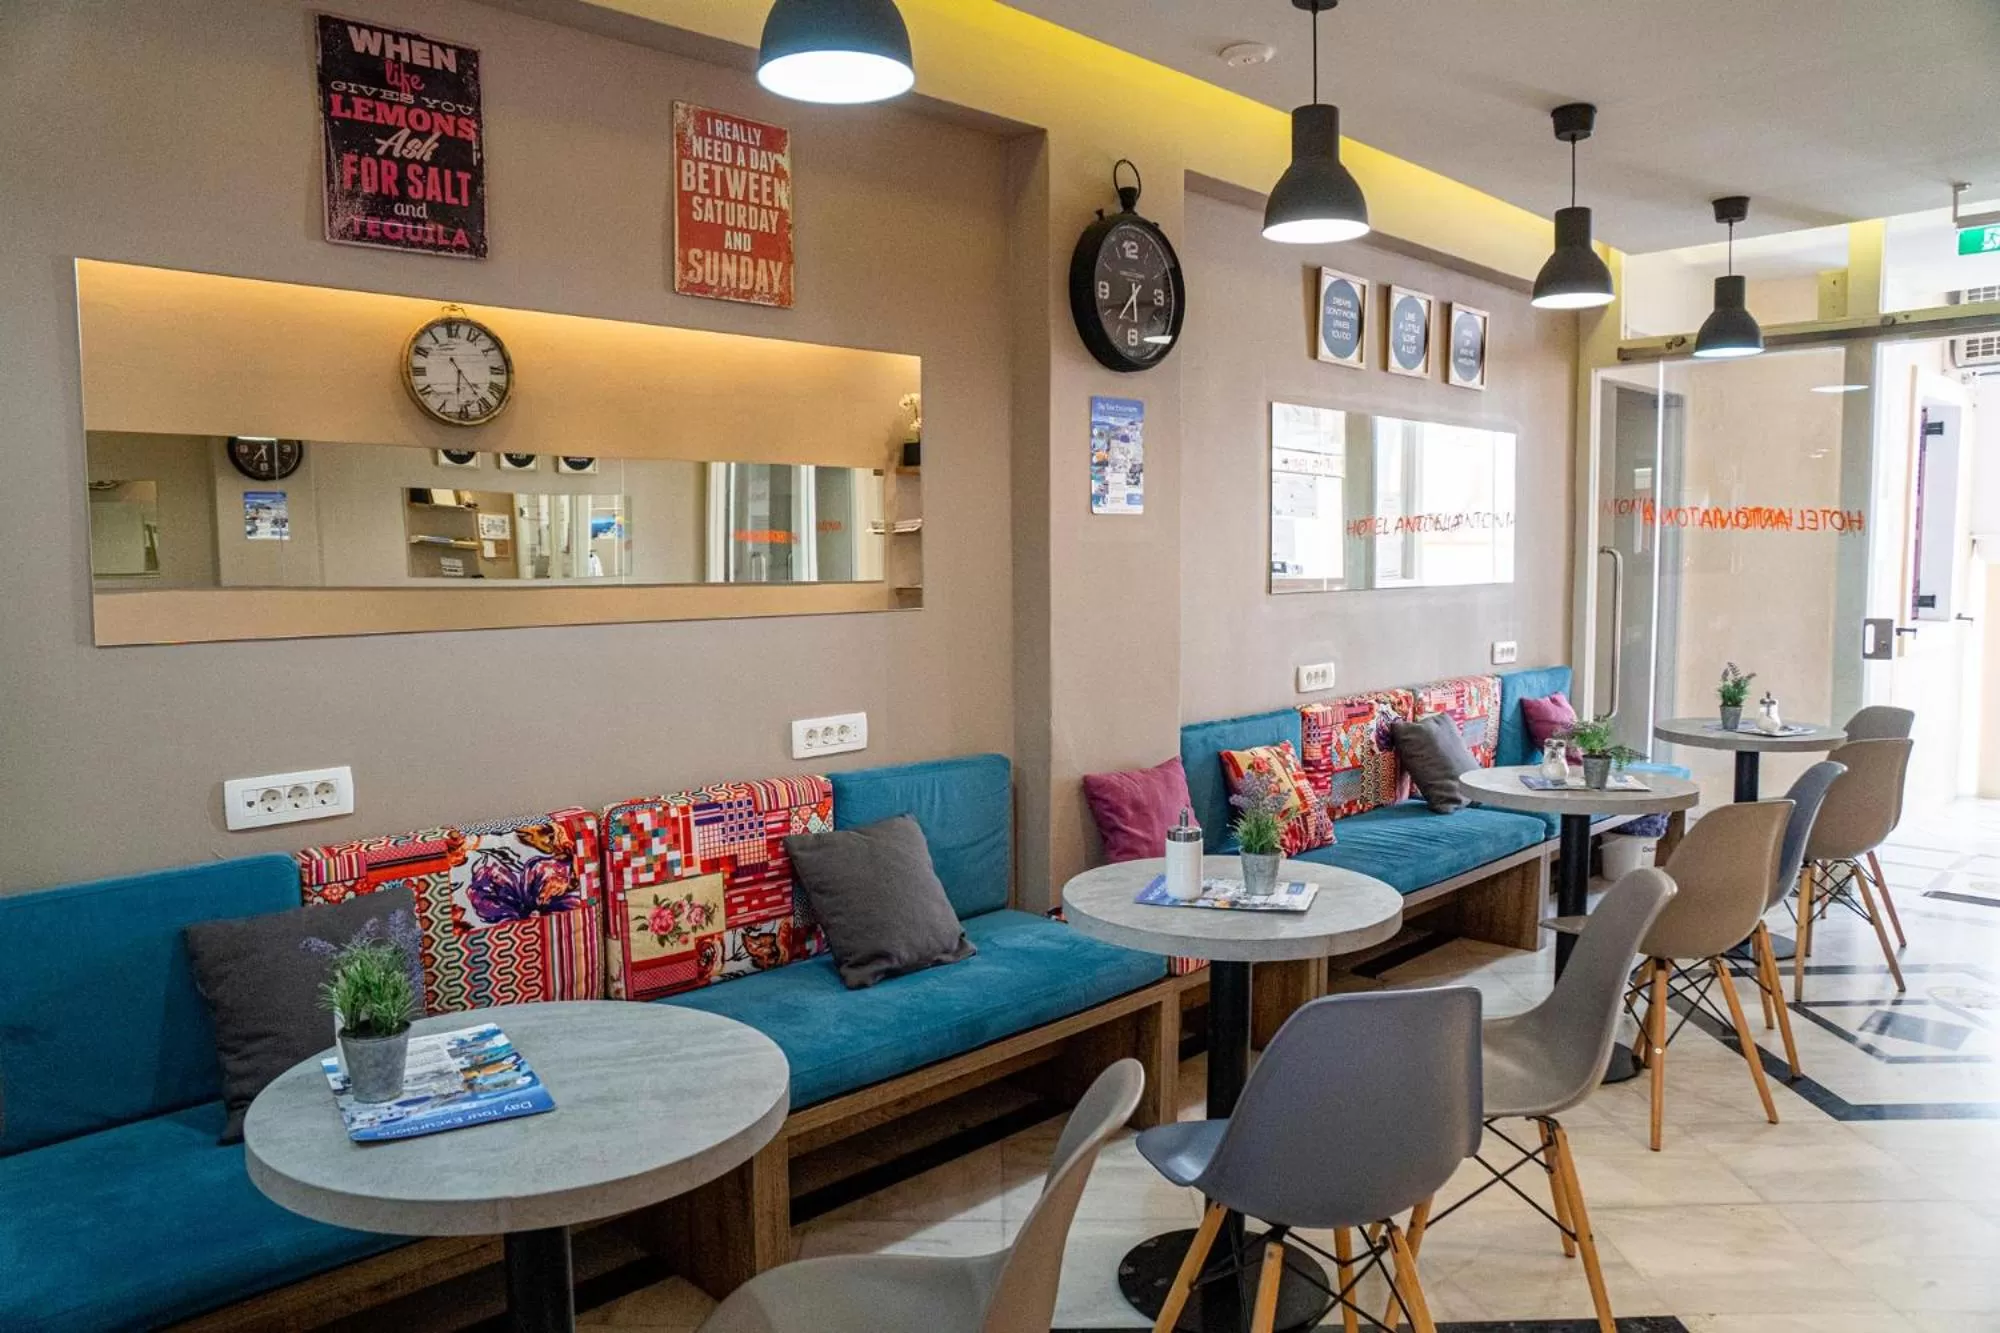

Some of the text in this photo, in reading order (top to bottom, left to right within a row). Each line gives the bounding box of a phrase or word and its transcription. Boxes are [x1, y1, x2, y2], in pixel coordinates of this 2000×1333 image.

[347, 25, 457, 73] WHEN
[384, 60, 424, 92] life
[330, 81, 474, 115] GIVES YOU
[330, 94, 479, 142] LEMONS
[706, 117, 762, 147] I REALLY
[375, 128, 441, 162] Ask
[692, 136, 775, 174] NEED A DAY
[342, 153, 471, 207] FOR SALT
[681, 159, 789, 210] BETWEEN
[394, 202, 428, 219] and
[692, 195, 779, 235] SATURDAY
[351, 214, 470, 248] TEQUILA
[724, 230, 752, 253] AND
[1122, 241, 1139, 259] 12
[687, 248, 783, 295] SUNDAY
[1153, 289, 1165, 306] 3
[376, 1100, 533, 1137] Day Tour Excursions
